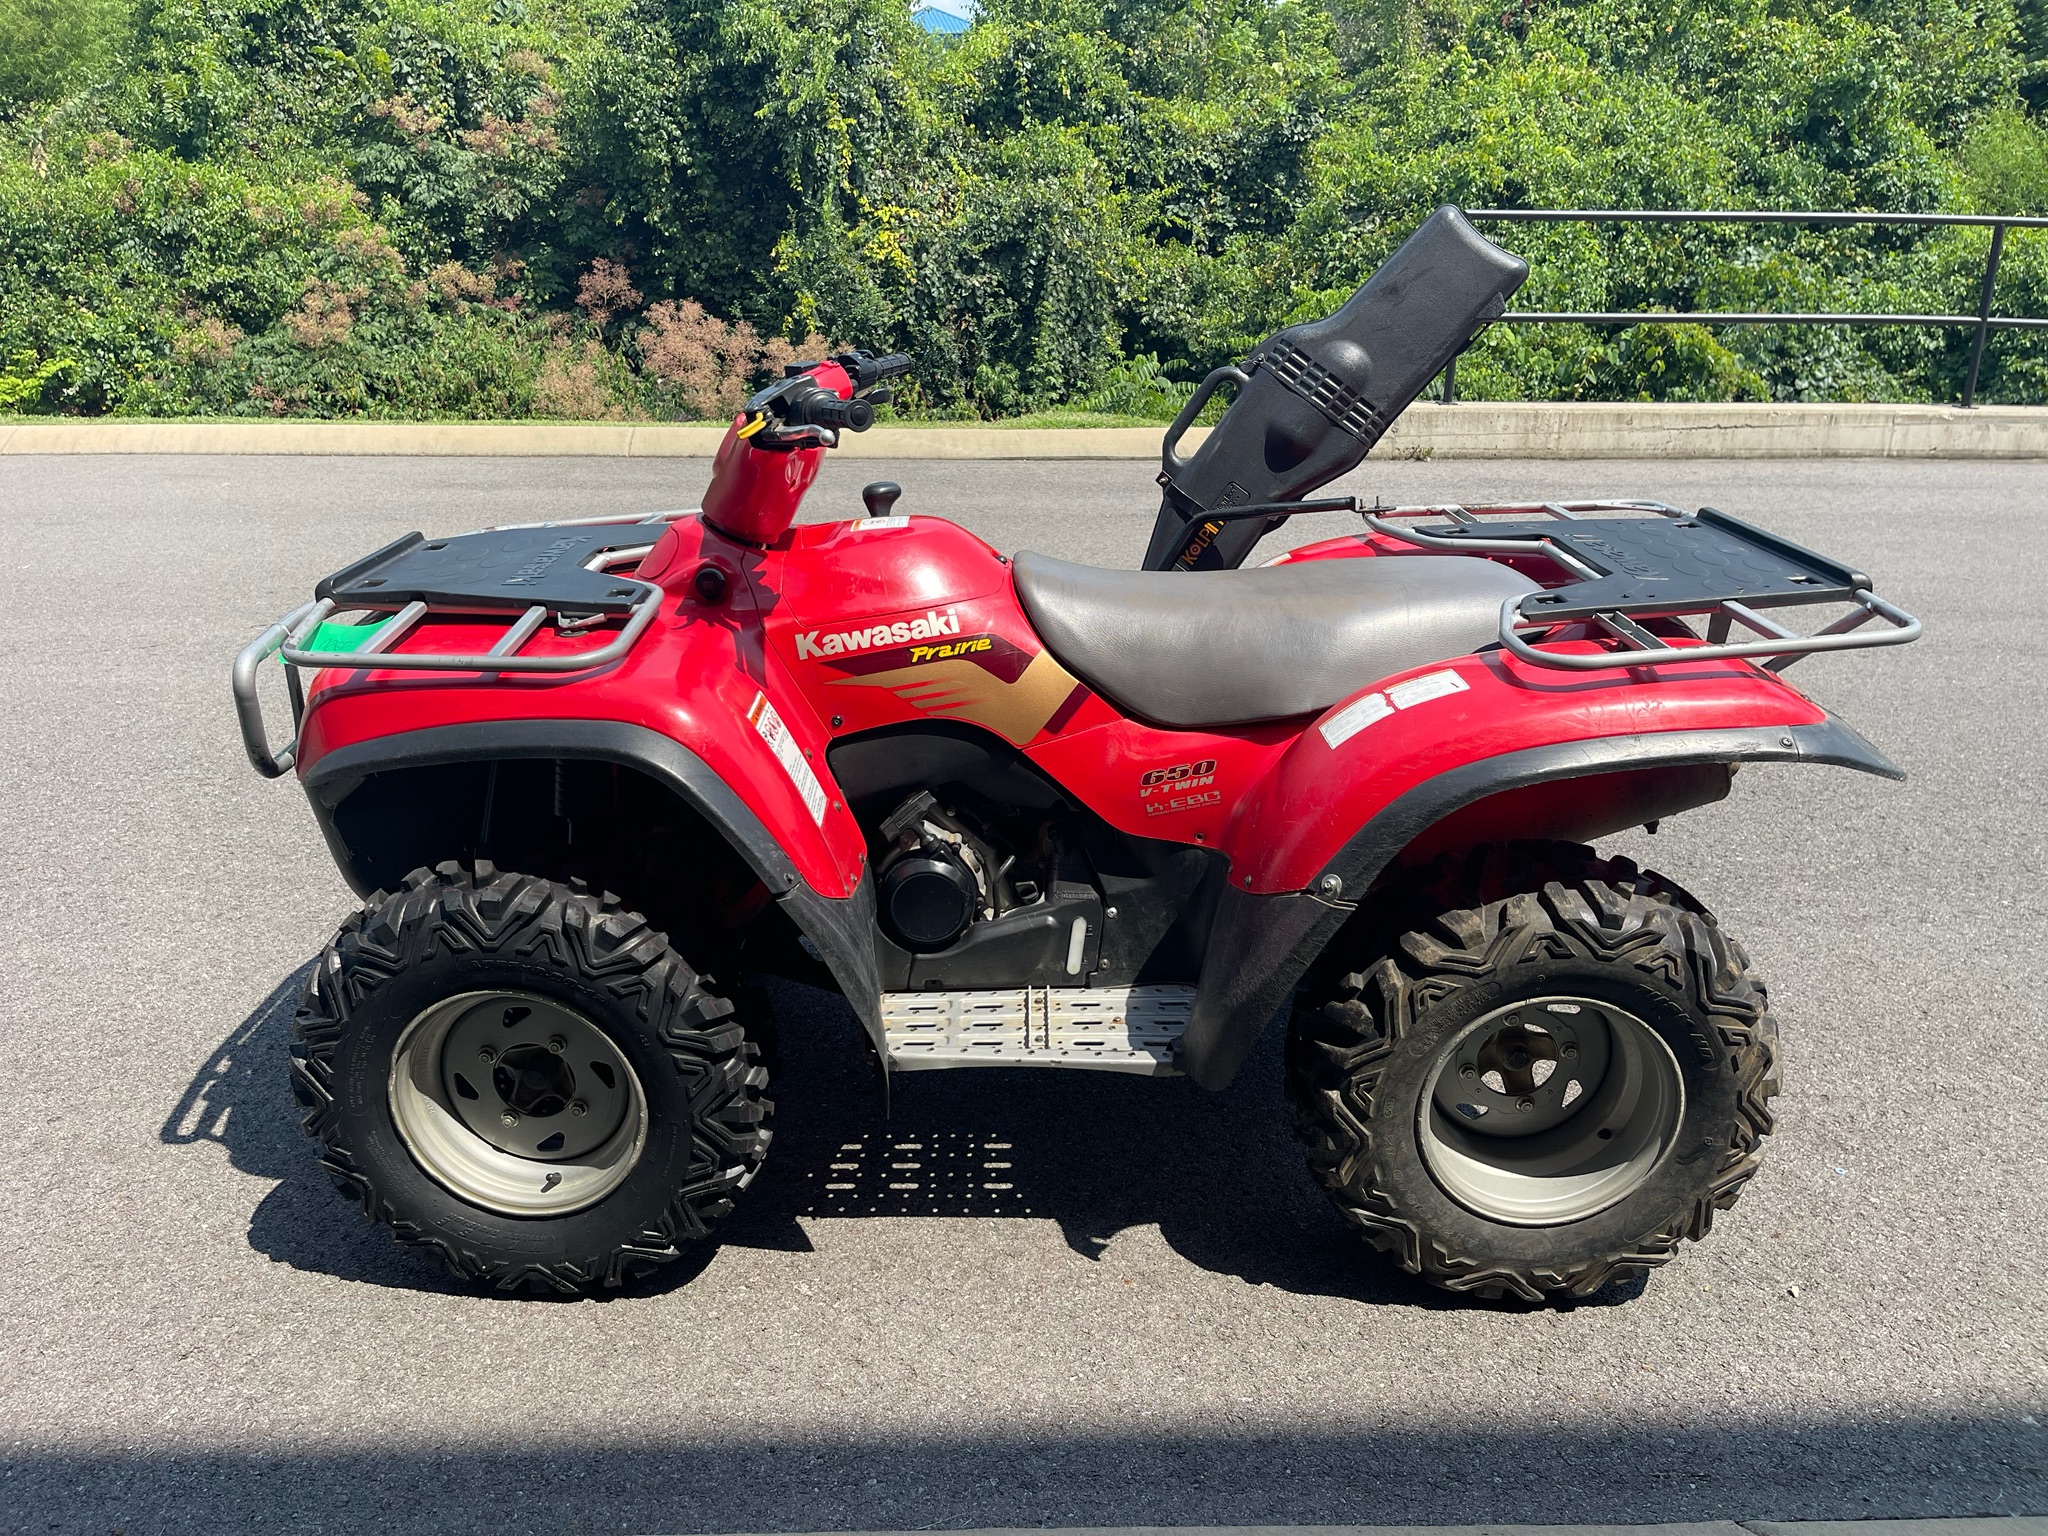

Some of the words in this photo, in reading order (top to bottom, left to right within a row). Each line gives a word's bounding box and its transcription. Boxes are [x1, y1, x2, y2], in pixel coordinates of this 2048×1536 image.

[794, 608, 960, 661] Kawasaki
[909, 638, 992, 663] Prairie
[1141, 759, 1217, 786] 650
[1140, 776, 1214, 797] V-TWIN
[1146, 791, 1221, 813] K-EBC
